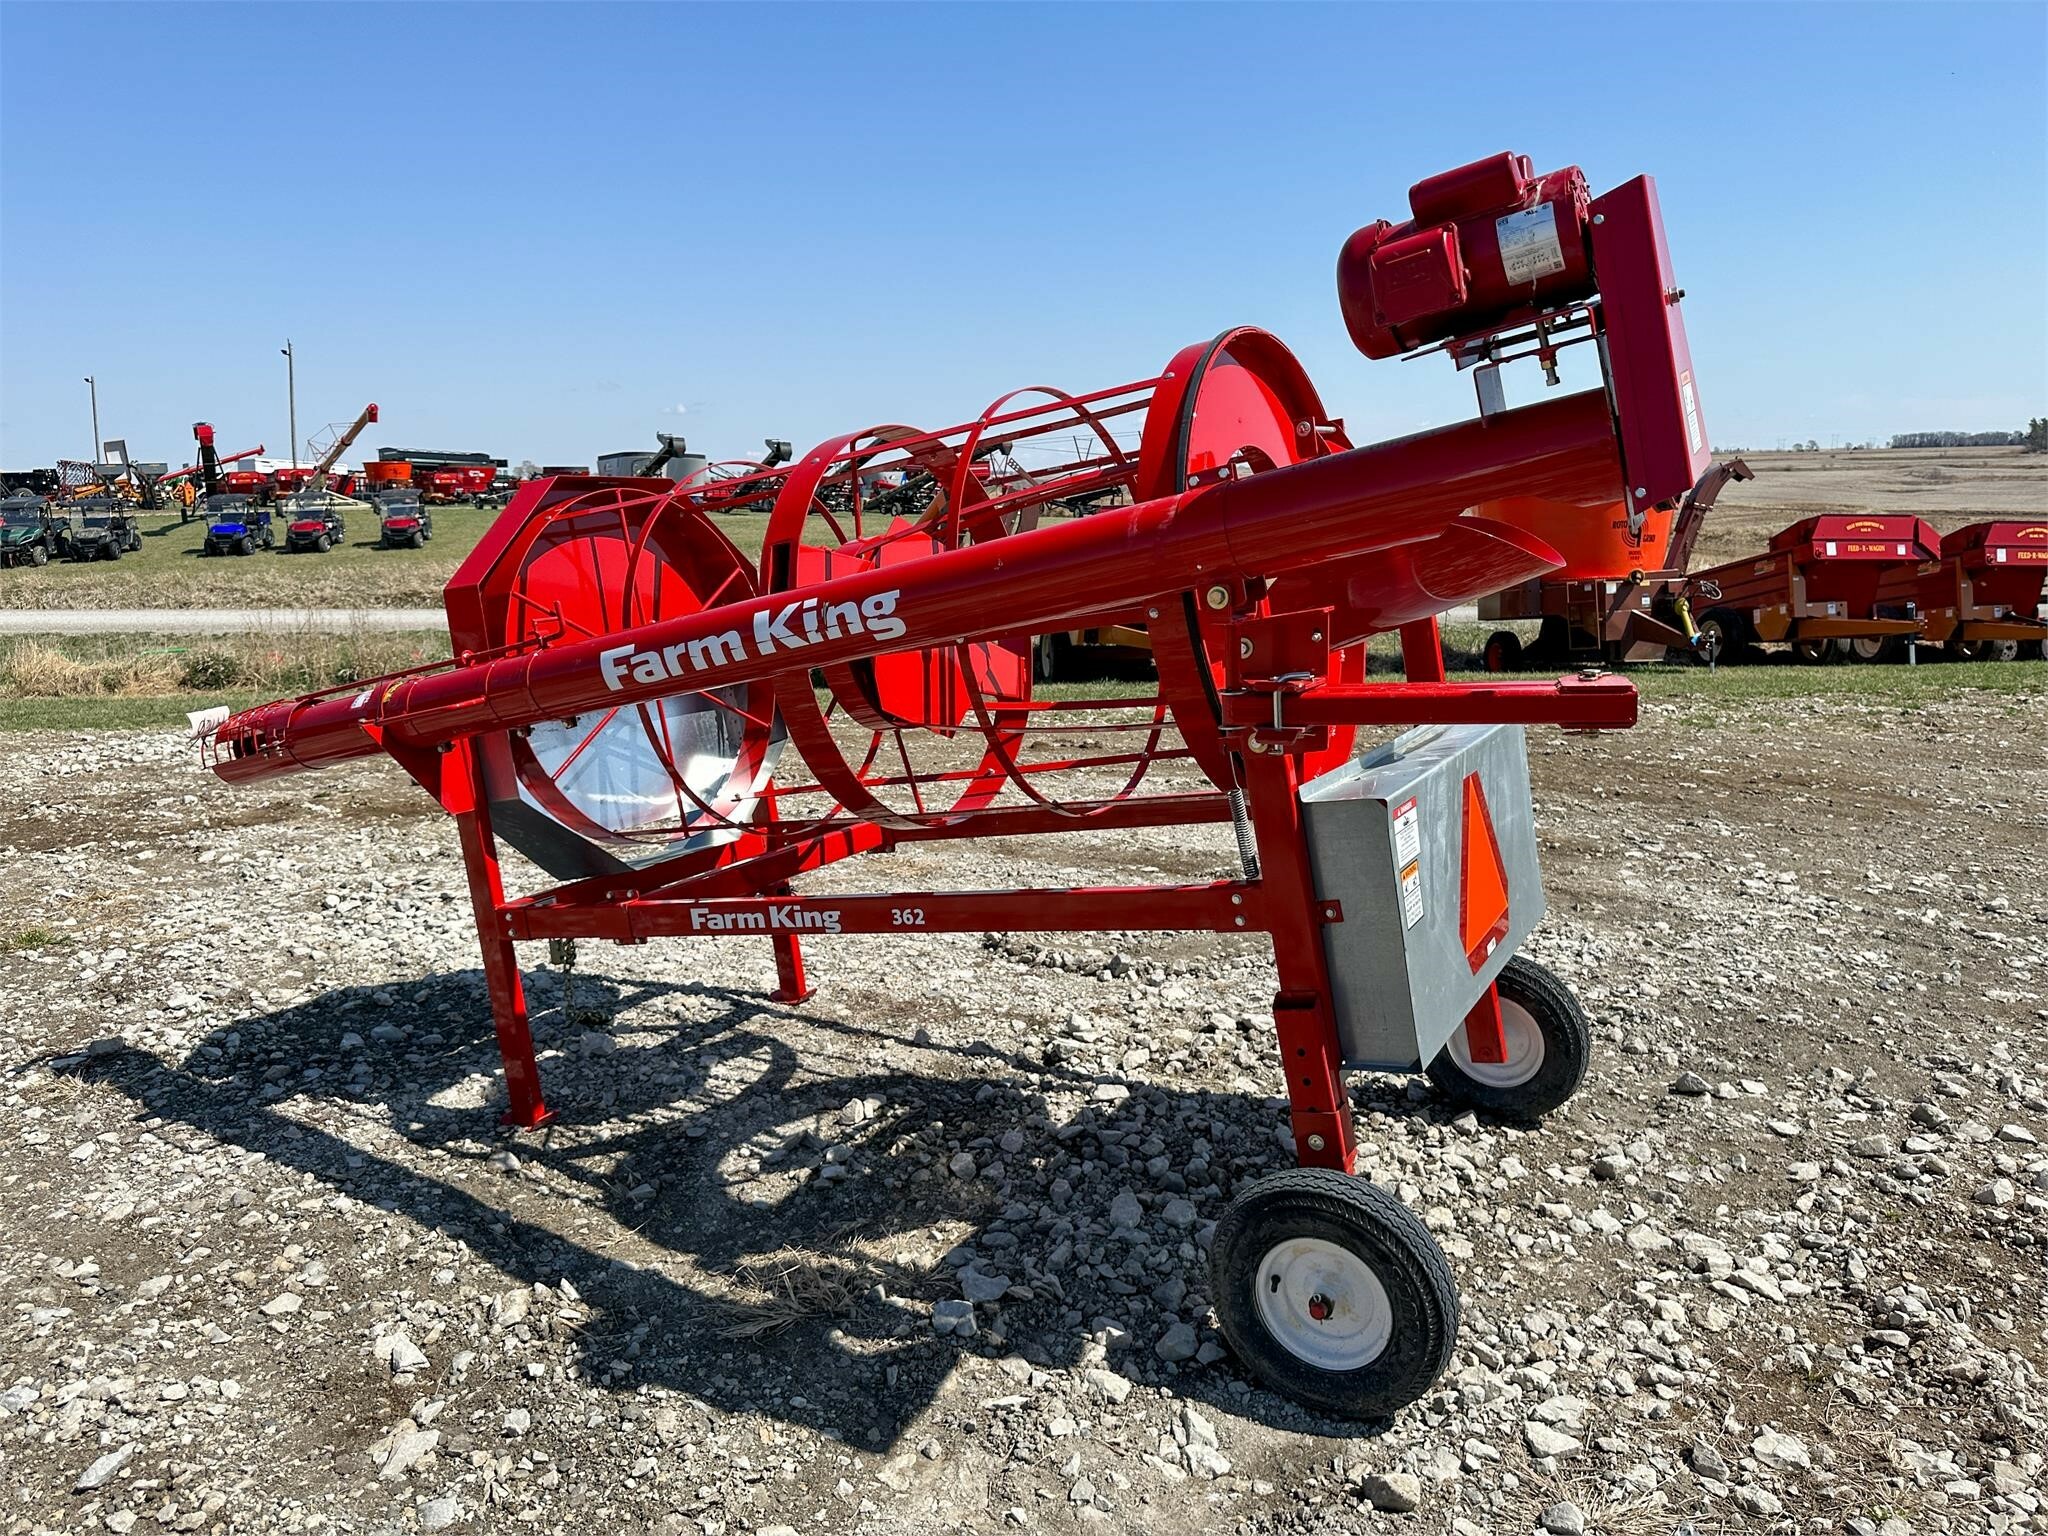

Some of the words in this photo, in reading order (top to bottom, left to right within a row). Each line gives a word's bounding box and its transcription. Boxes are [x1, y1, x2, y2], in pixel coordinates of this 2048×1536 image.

[600, 631, 749, 692] Farm
[753, 589, 907, 656] King
[690, 907, 766, 930] Farm
[768, 905, 842, 934] King
[891, 908, 926, 926] 362
